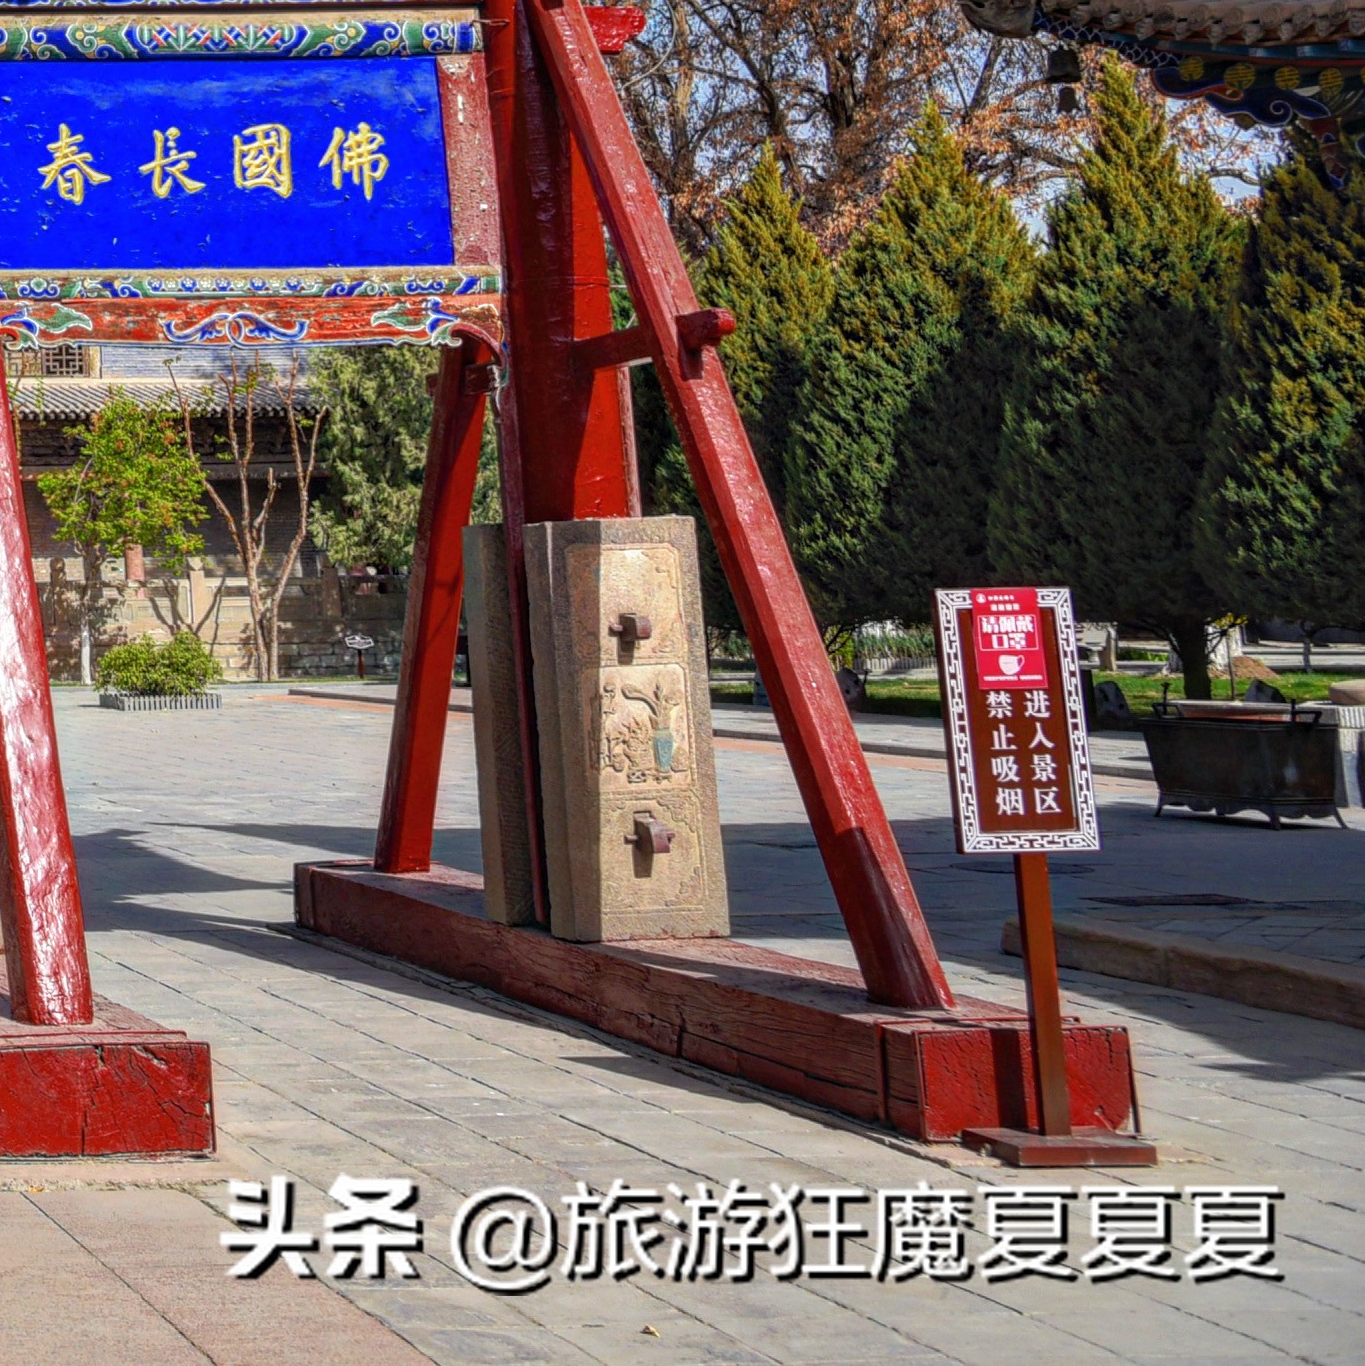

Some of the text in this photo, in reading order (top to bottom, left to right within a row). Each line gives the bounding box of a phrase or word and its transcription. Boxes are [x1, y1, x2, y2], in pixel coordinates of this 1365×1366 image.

[37, 122, 390, 206] 佛國長春
[991, 633, 1027, 649] 口罩
[986, 691, 1025, 815] 禁止吸烟
